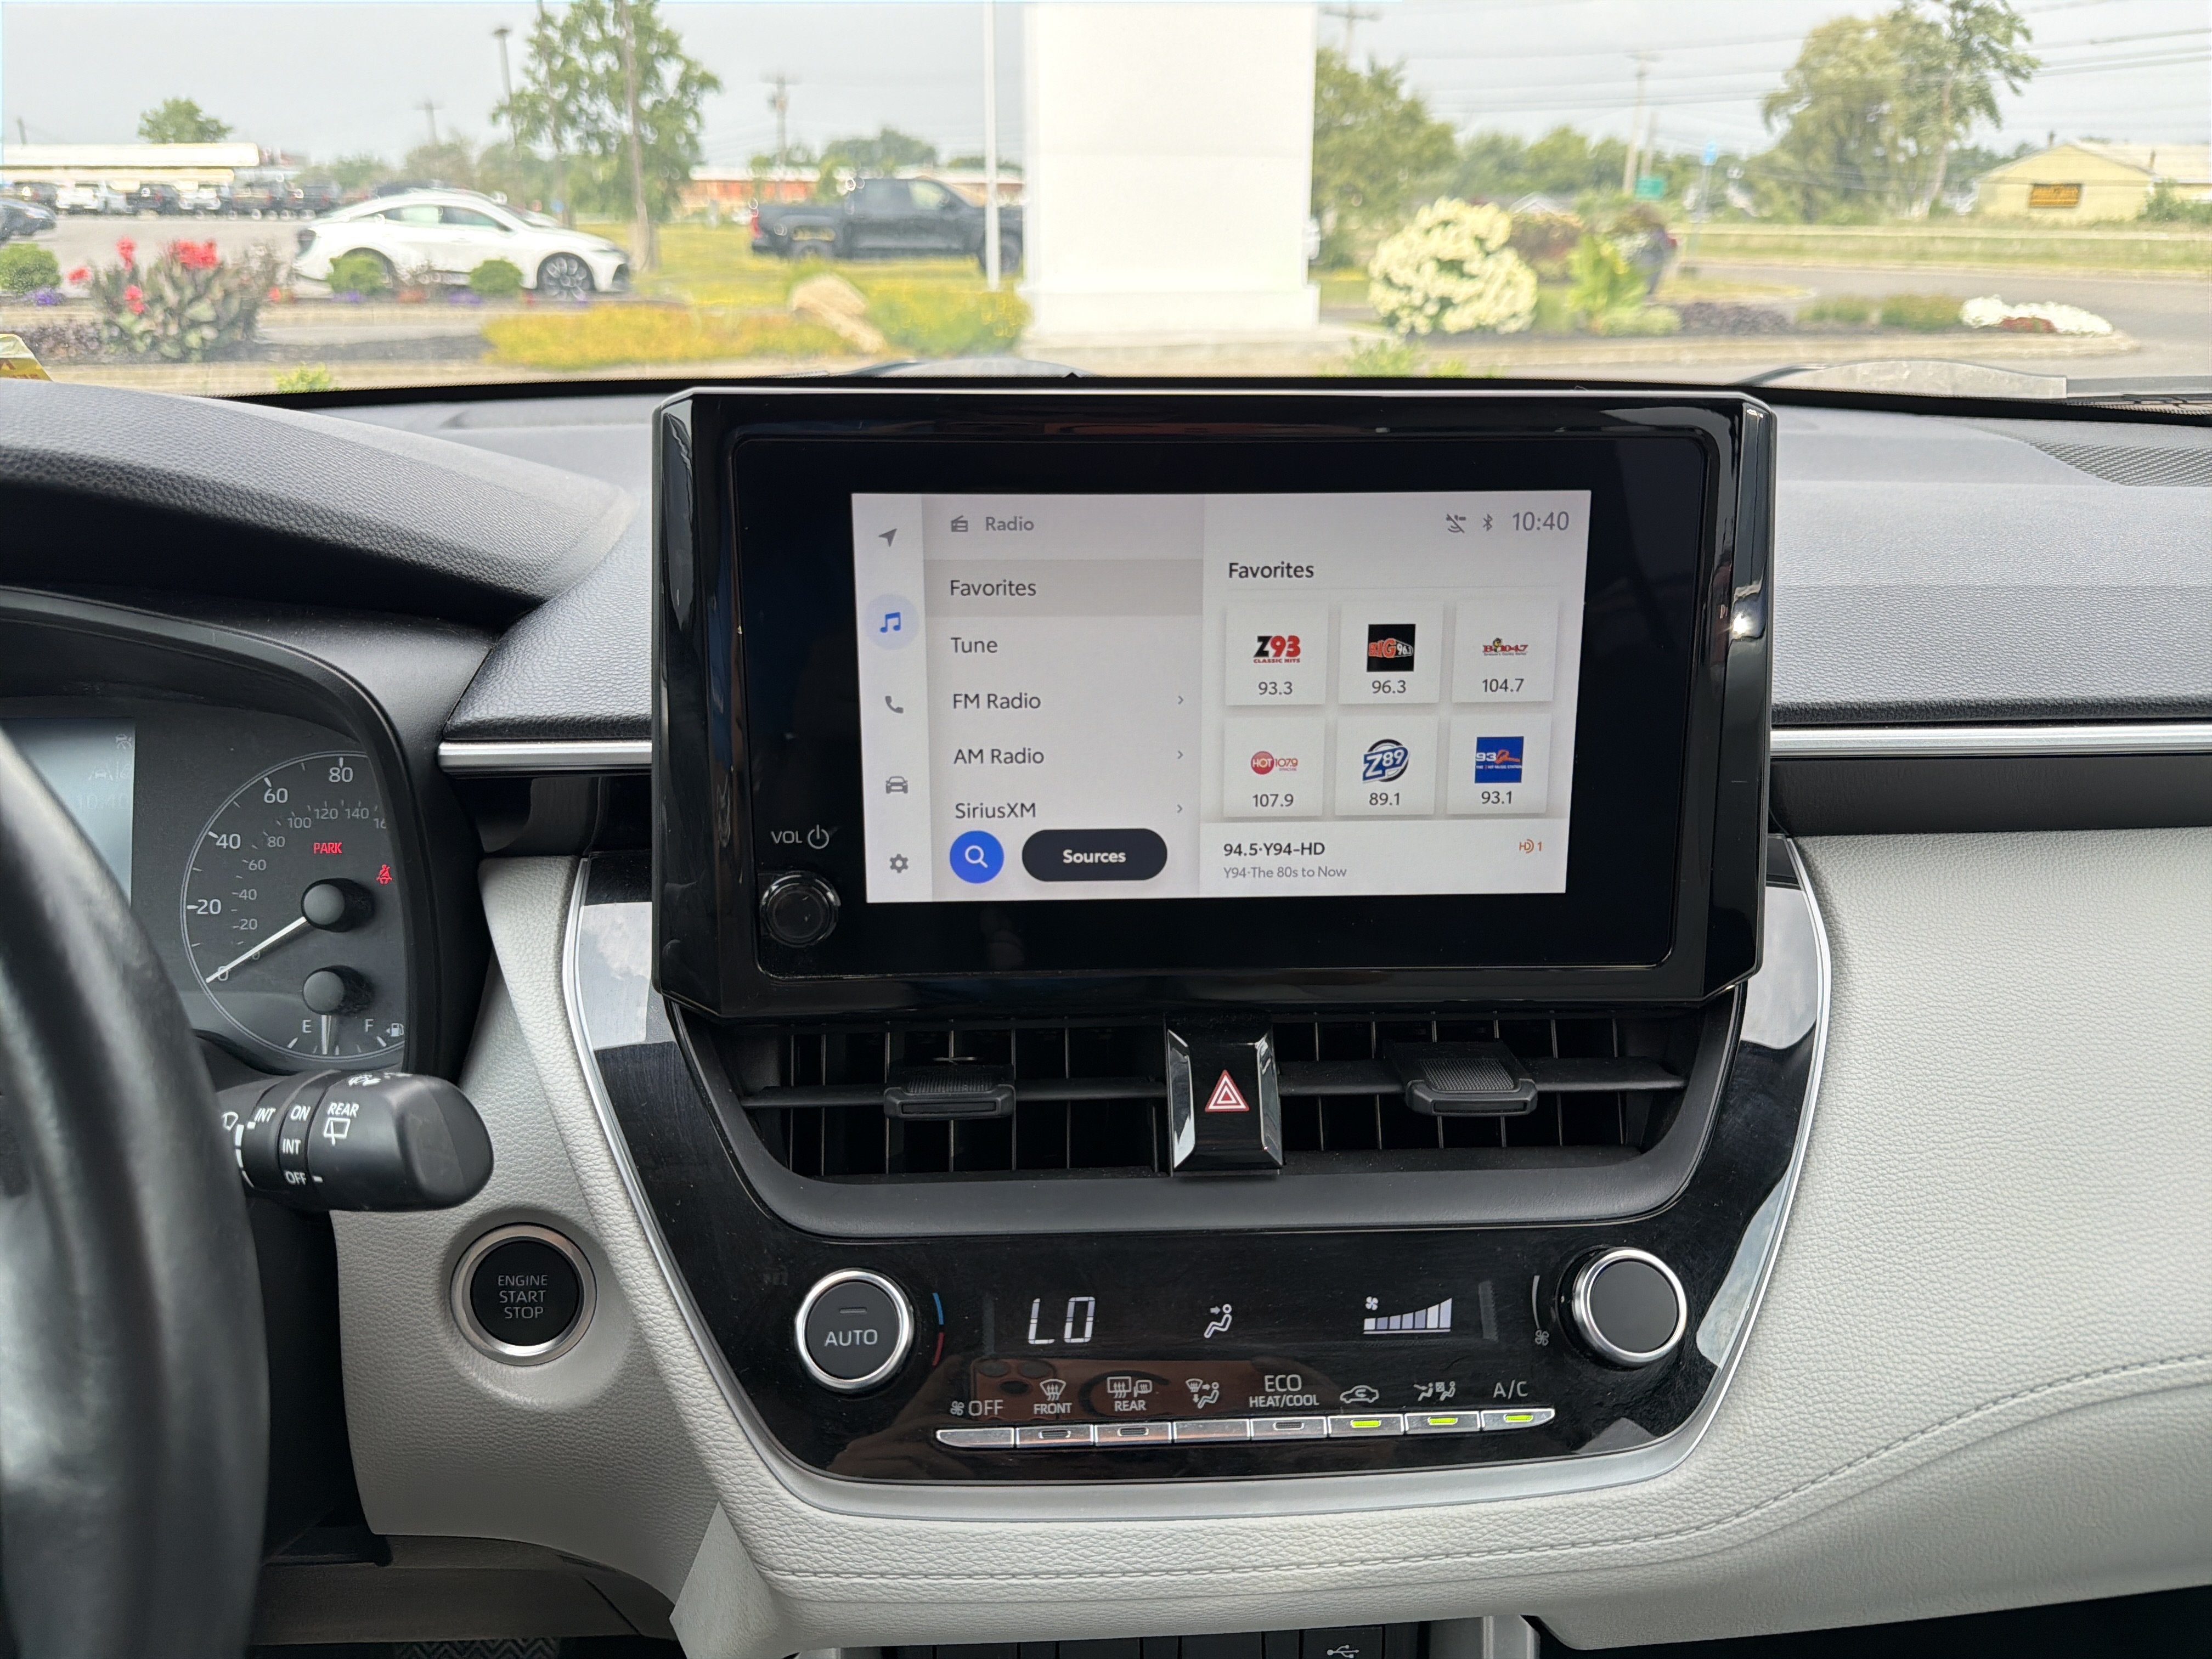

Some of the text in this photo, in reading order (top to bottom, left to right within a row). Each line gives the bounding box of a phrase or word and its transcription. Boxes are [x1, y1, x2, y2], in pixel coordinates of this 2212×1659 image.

[985, 516, 1035, 531] Radio
[1513, 511, 1569, 531] 10:40
[1229, 561, 1314, 579] Favorites
[950, 579, 1036, 596] Favorites
[950, 637, 998, 653] Tune
[1254, 635, 1301, 658] Z93
[1369, 638, 1396, 658] BIG
[1258, 681, 1293, 696] 93.3
[1372, 680, 1407, 694] 96.3
[1482, 678, 1525, 692] 104.7
[953, 692, 1041, 709] FM Radio
[953, 747, 1045, 764] AM Radio
[1252, 758, 1298, 768] HOT 107.9
[1365, 749, 1404, 777] Z89
[329, 767, 353, 782] 80
[264, 788, 288, 803] 60
[1252, 793, 1294, 808] 107.9
[1369, 792, 1400, 806] 89.1
[1481, 791, 1512, 804] 93.1
[314, 808, 338, 820] 120
[345, 807, 369, 819] 140
[955, 802, 1036, 819] SiriusXM
[287, 817, 312, 828] 100
[374, 818, 387, 829] 16
[216, 833, 241, 850] 40
[267, 836, 285, 848] 80
[771, 831, 803, 844] VOL
[313, 842, 342, 854] PARK
[1063, 849, 1126, 864] Sources
[248, 859, 267, 871] 60
[1277, 866, 1299, 878] 80s
[1301, 867, 1315, 878] to
[1318, 866, 1347, 877] Now
[239, 889, 257, 900] 40
[196, 899, 222, 915] 20
[239, 918, 258, 930] 20
[302, 1019, 312, 1034] E
[364, 1018, 374, 1032] F
[254, 1107, 276, 1122] INT
[290, 1105, 311, 1121] ON
[327, 1102, 359, 1119] REAR
[282, 1138, 301, 1154] INT
[285, 1171, 307, 1184] OFF
[498, 1274, 548, 1287] ENGINE
[499, 1290, 546, 1304] START
[504, 1306, 544, 1319] STOP
[1028, 1296, 1095, 1345] LO
[824, 1329, 878, 1346] AUTO
[1264, 1374, 1302, 1392] ECO
[1493, 1379, 1528, 1399] A/C
[968, 1399, 1003, 1417] OFF
[1034, 1402, 1073, 1415] FRONT
[1114, 1400, 1147, 1412] REAR
[1249, 1394, 1320, 1408] HEAT/COOL
